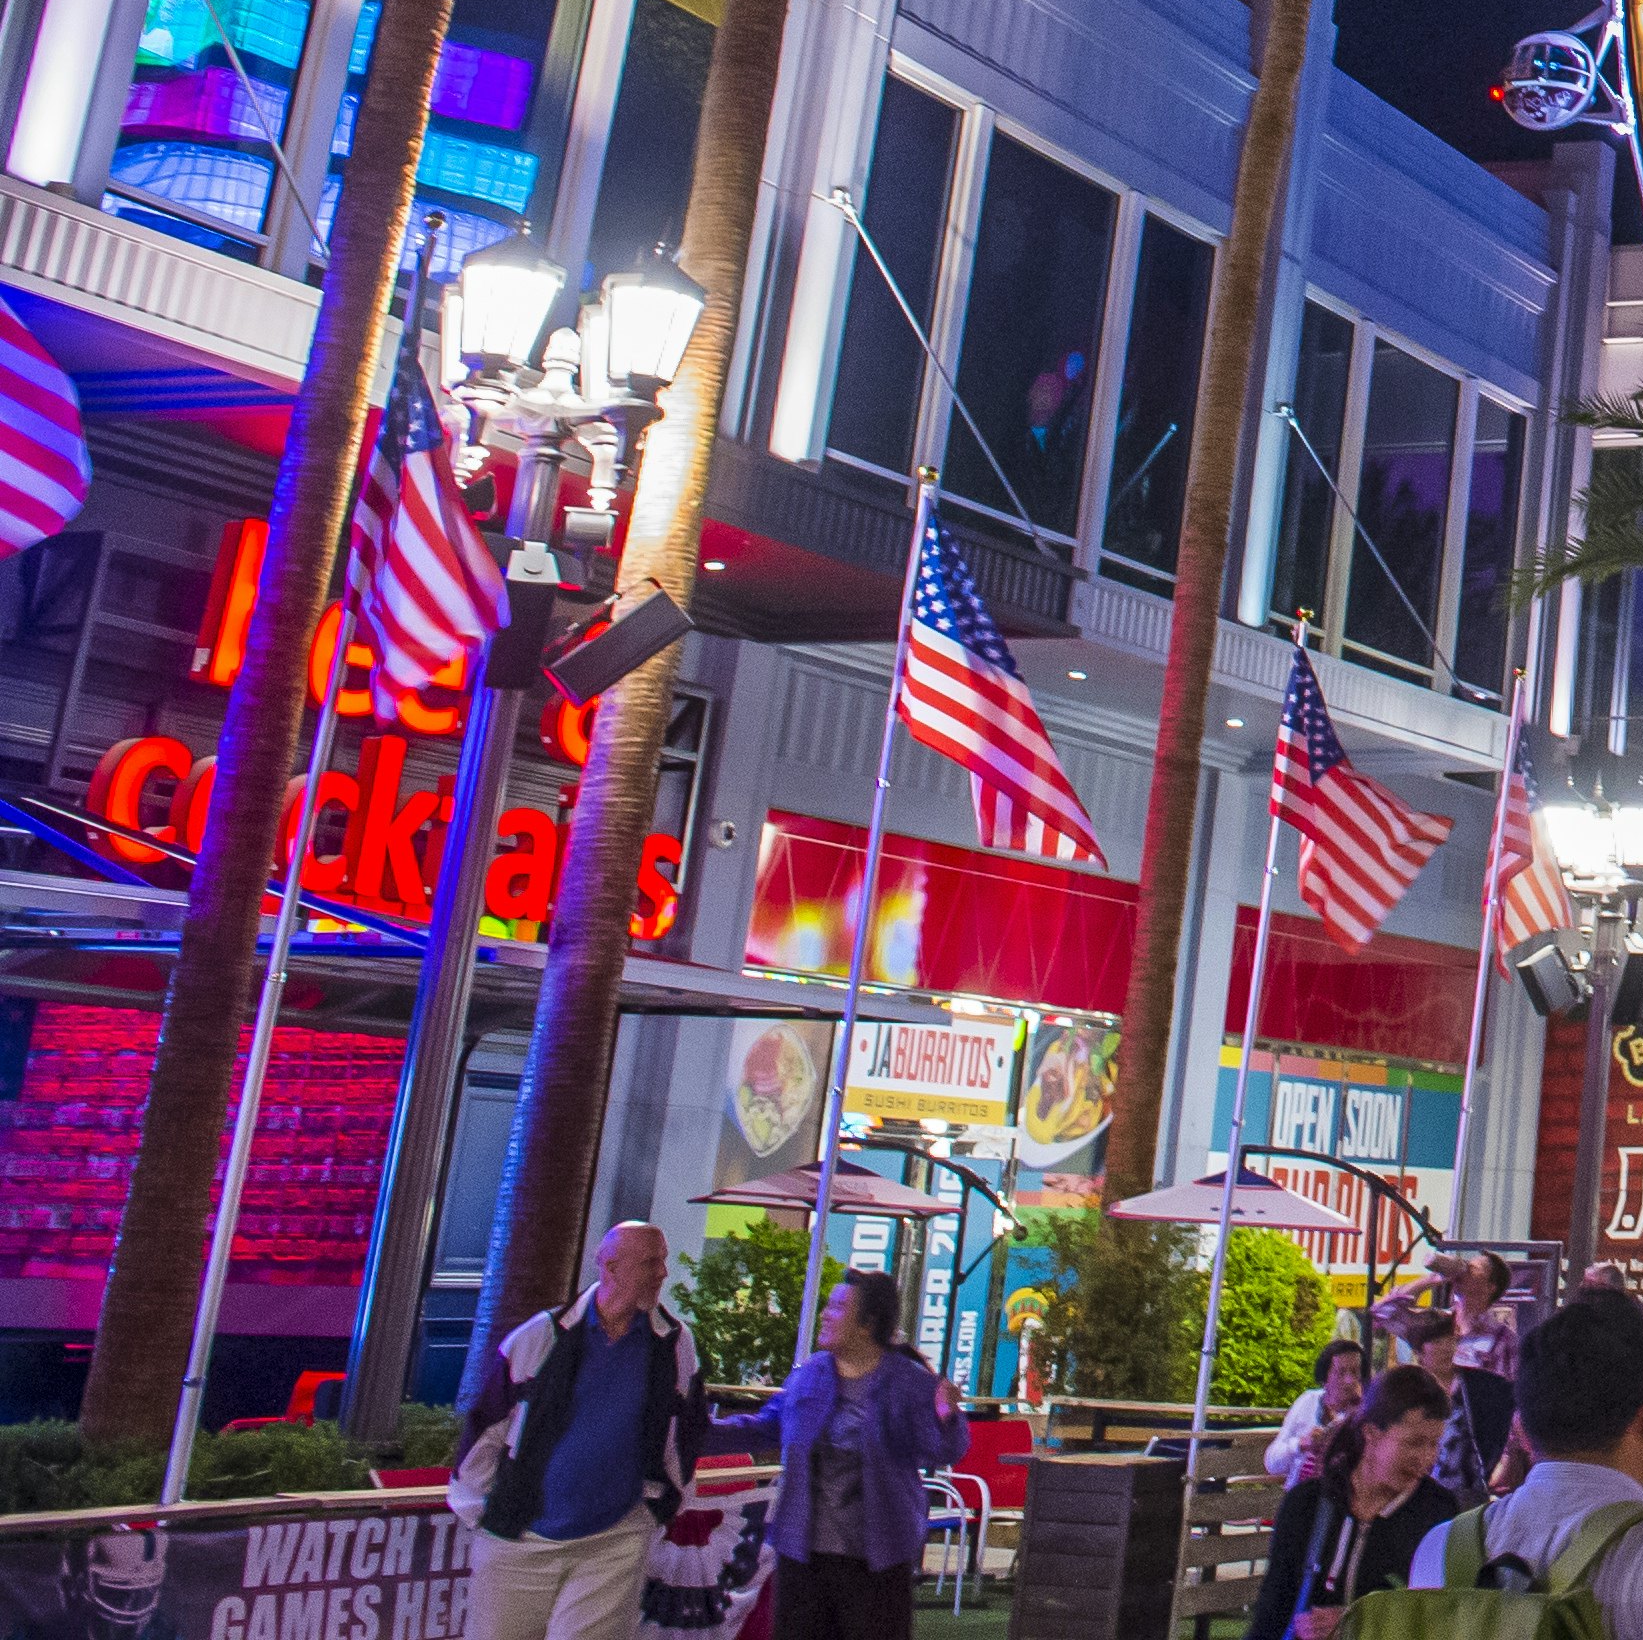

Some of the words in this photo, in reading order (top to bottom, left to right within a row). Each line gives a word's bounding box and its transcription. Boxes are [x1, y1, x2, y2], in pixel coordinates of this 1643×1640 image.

[864, 1093, 914, 1108] SUSHI
[917, 1098, 989, 1118] BURRITOS
[1273, 1081, 1335, 1155] OPEN
[1343, 1089, 1402, 1159] SOON
[242, 1515, 420, 1588] WATCH
[209, 1584, 383, 1640] GAMES
